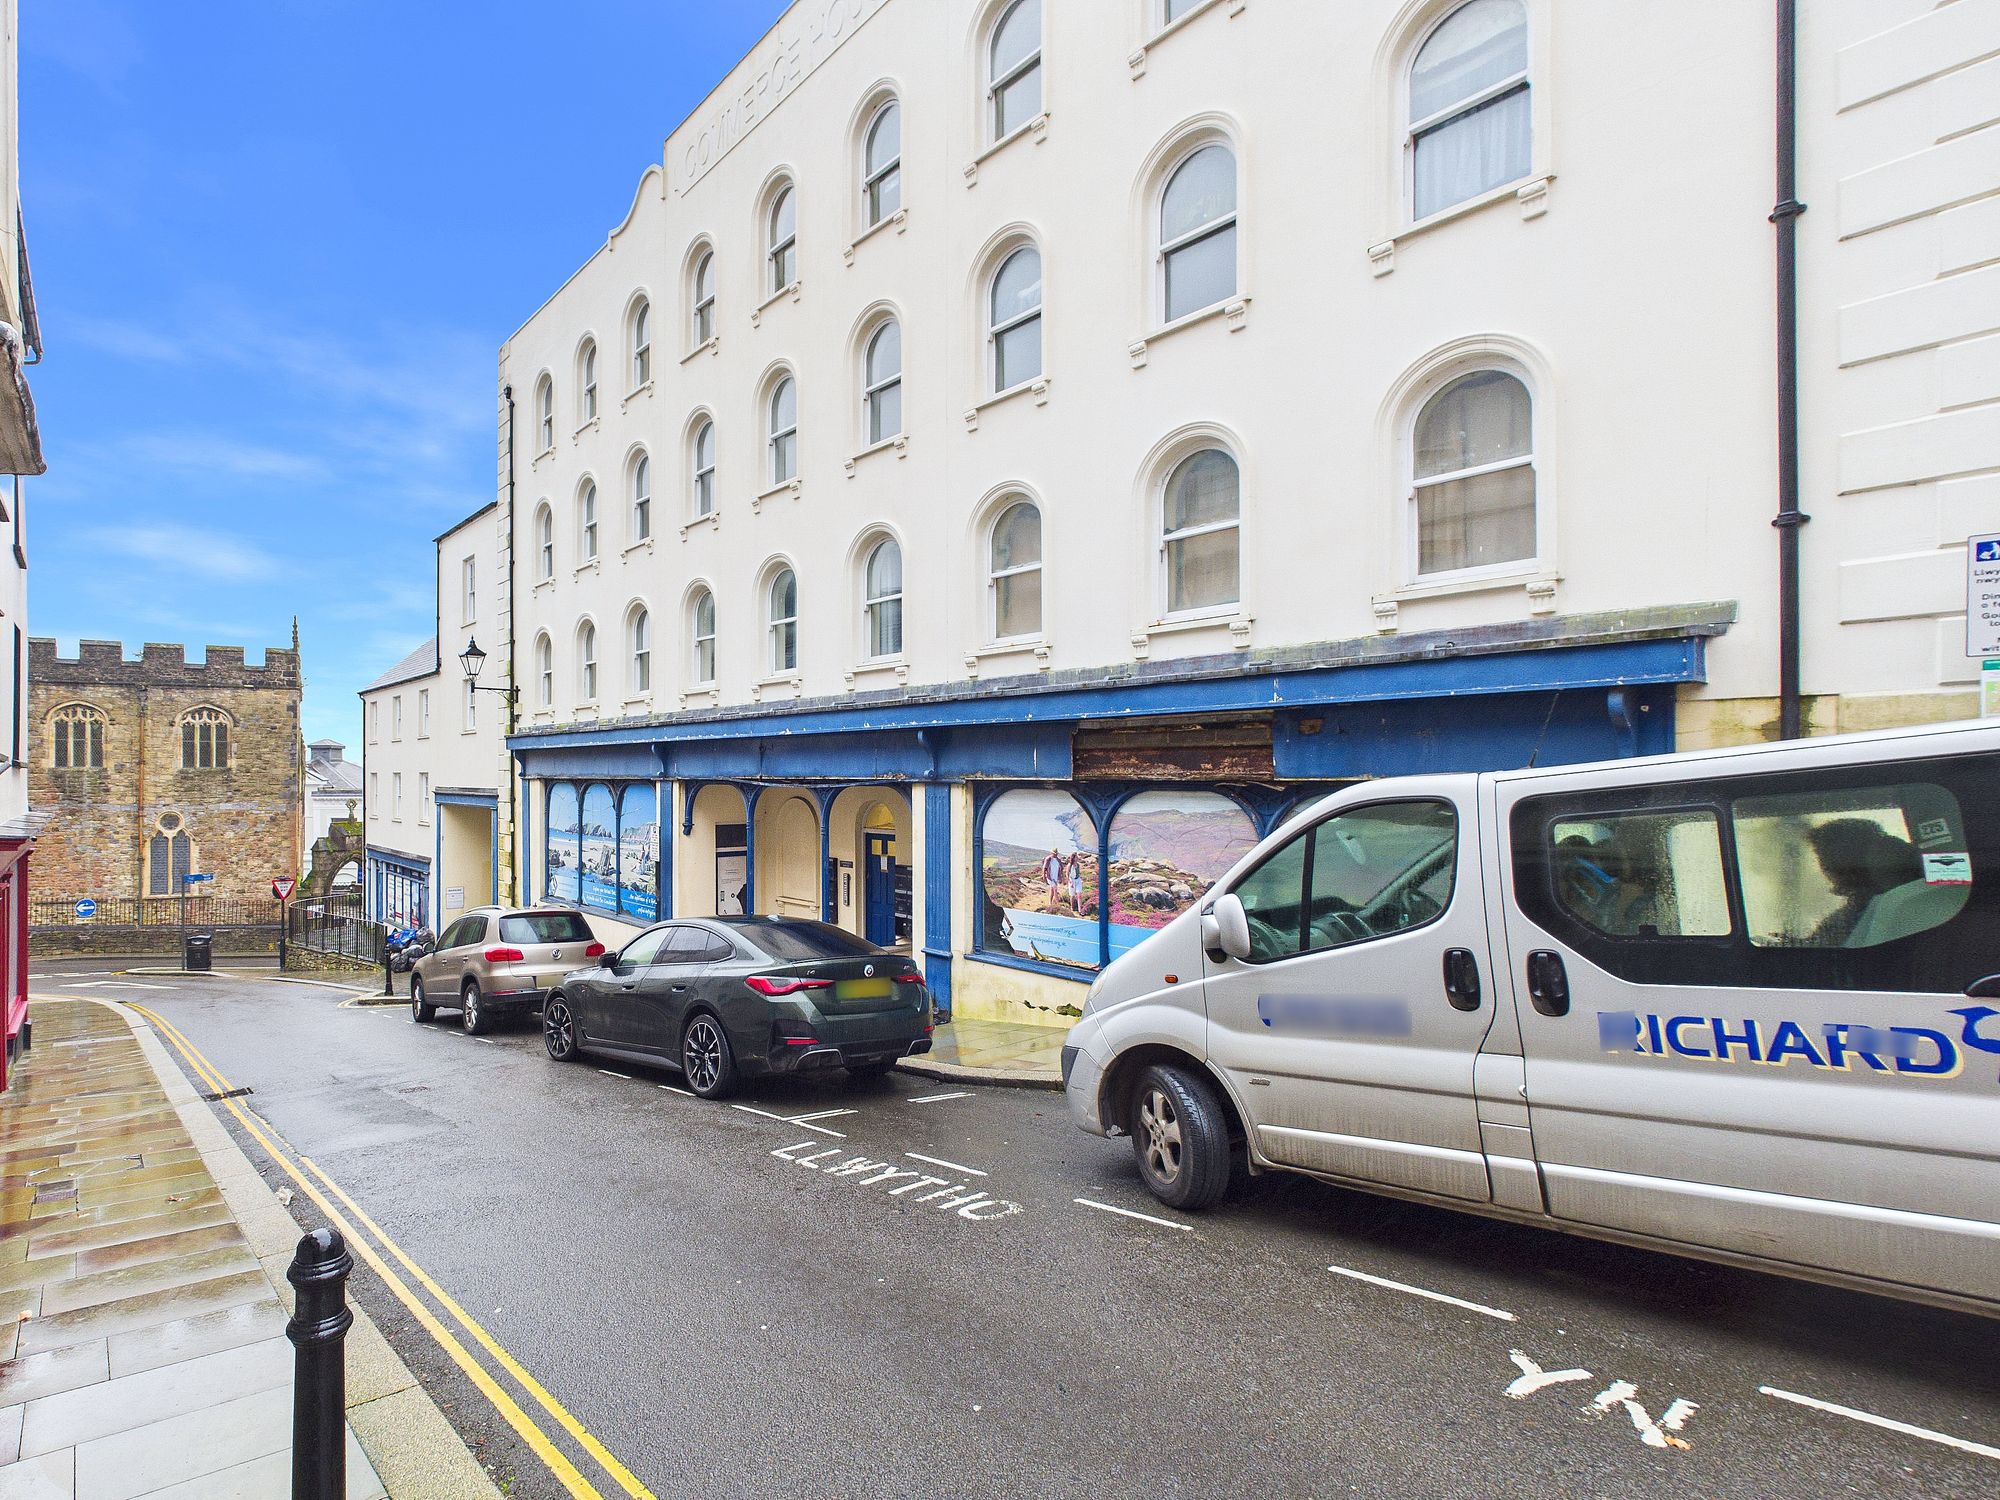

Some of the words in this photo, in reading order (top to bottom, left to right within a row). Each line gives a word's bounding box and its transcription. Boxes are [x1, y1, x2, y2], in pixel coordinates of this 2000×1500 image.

[684, 36, 802, 179] COMMERCE
[809, 0, 879, 68] HO
[770, 1141, 1024, 1220] LLWYTHO
[1502, 1347, 1700, 1448] YN
